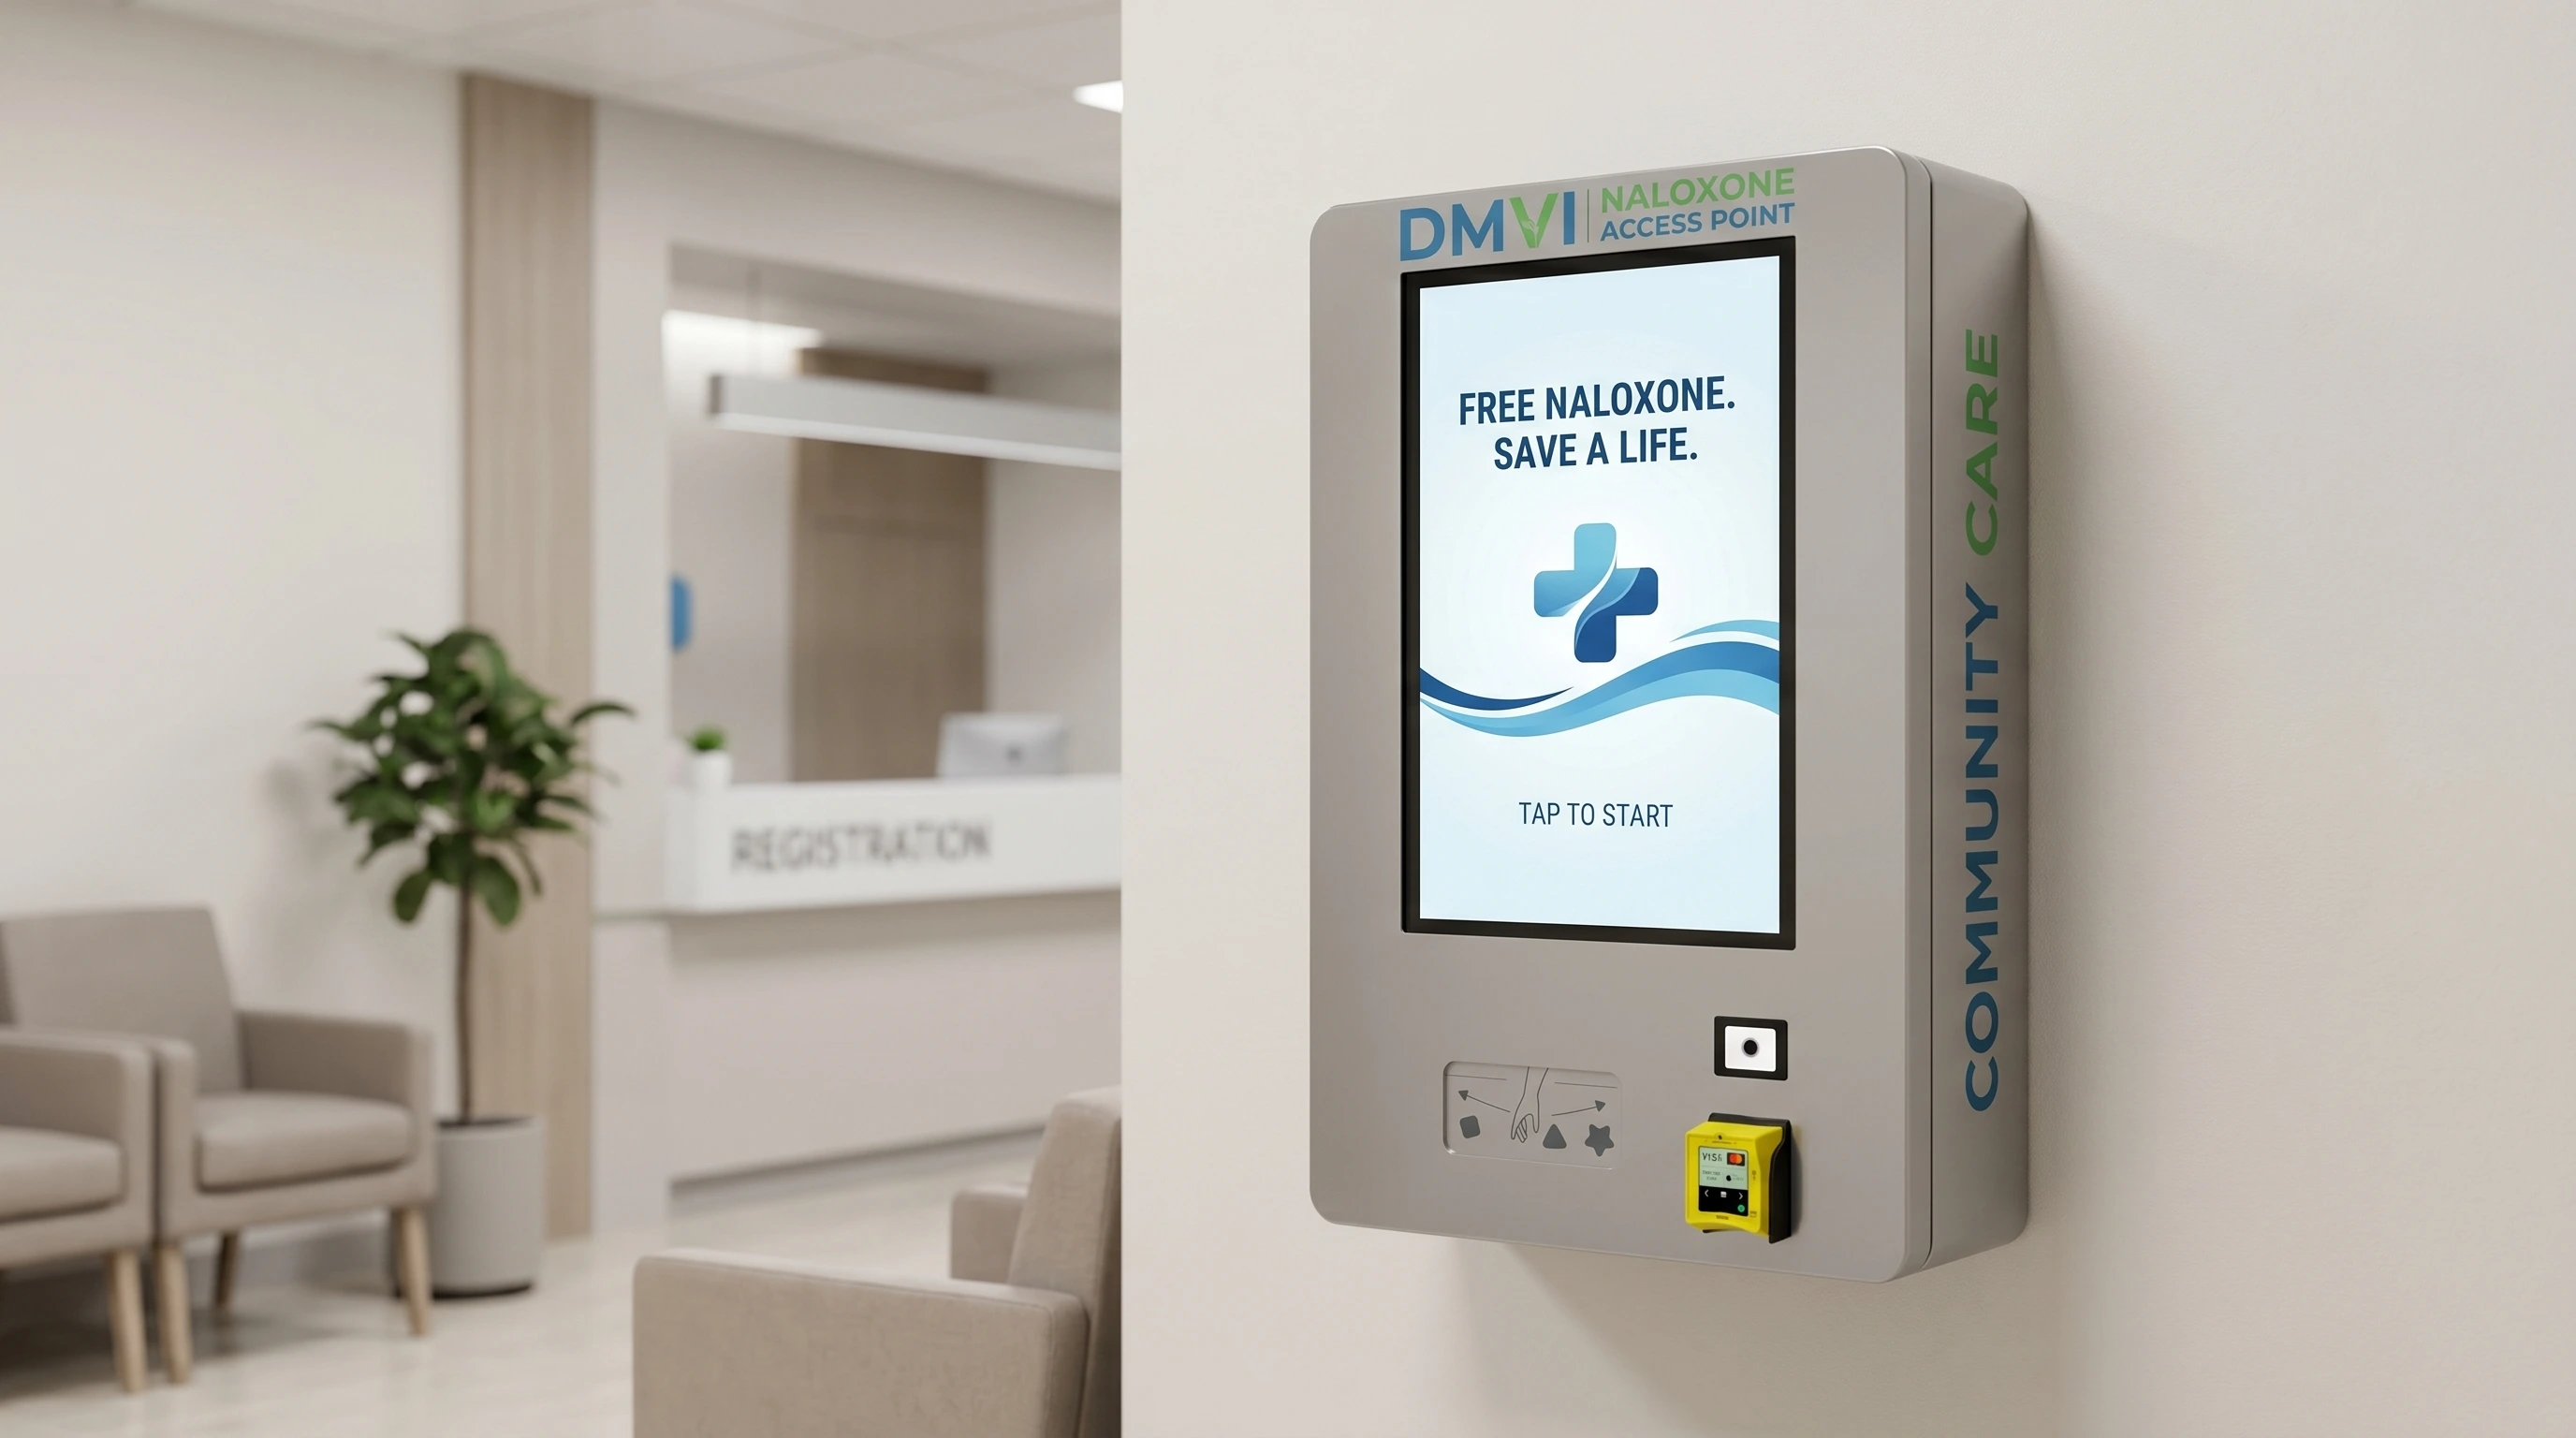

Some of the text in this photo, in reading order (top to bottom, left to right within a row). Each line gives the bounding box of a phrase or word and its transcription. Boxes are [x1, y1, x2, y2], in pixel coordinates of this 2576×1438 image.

[1602, 168, 1795, 213] NALOXONE
[1399, 190, 1575, 261] DMVI
[1600, 202, 1795, 242] ACCESS POINT
[1459, 375, 1736, 425] FREE NALOXONE.
[1494, 426, 1698, 470] SAVE A LIFE.
[1965, 328, 1999, 1112] COMMUNITY CARE
[1518, 801, 1674, 828] TAP TO START
[732, 819, 991, 872] REGISTRATION
